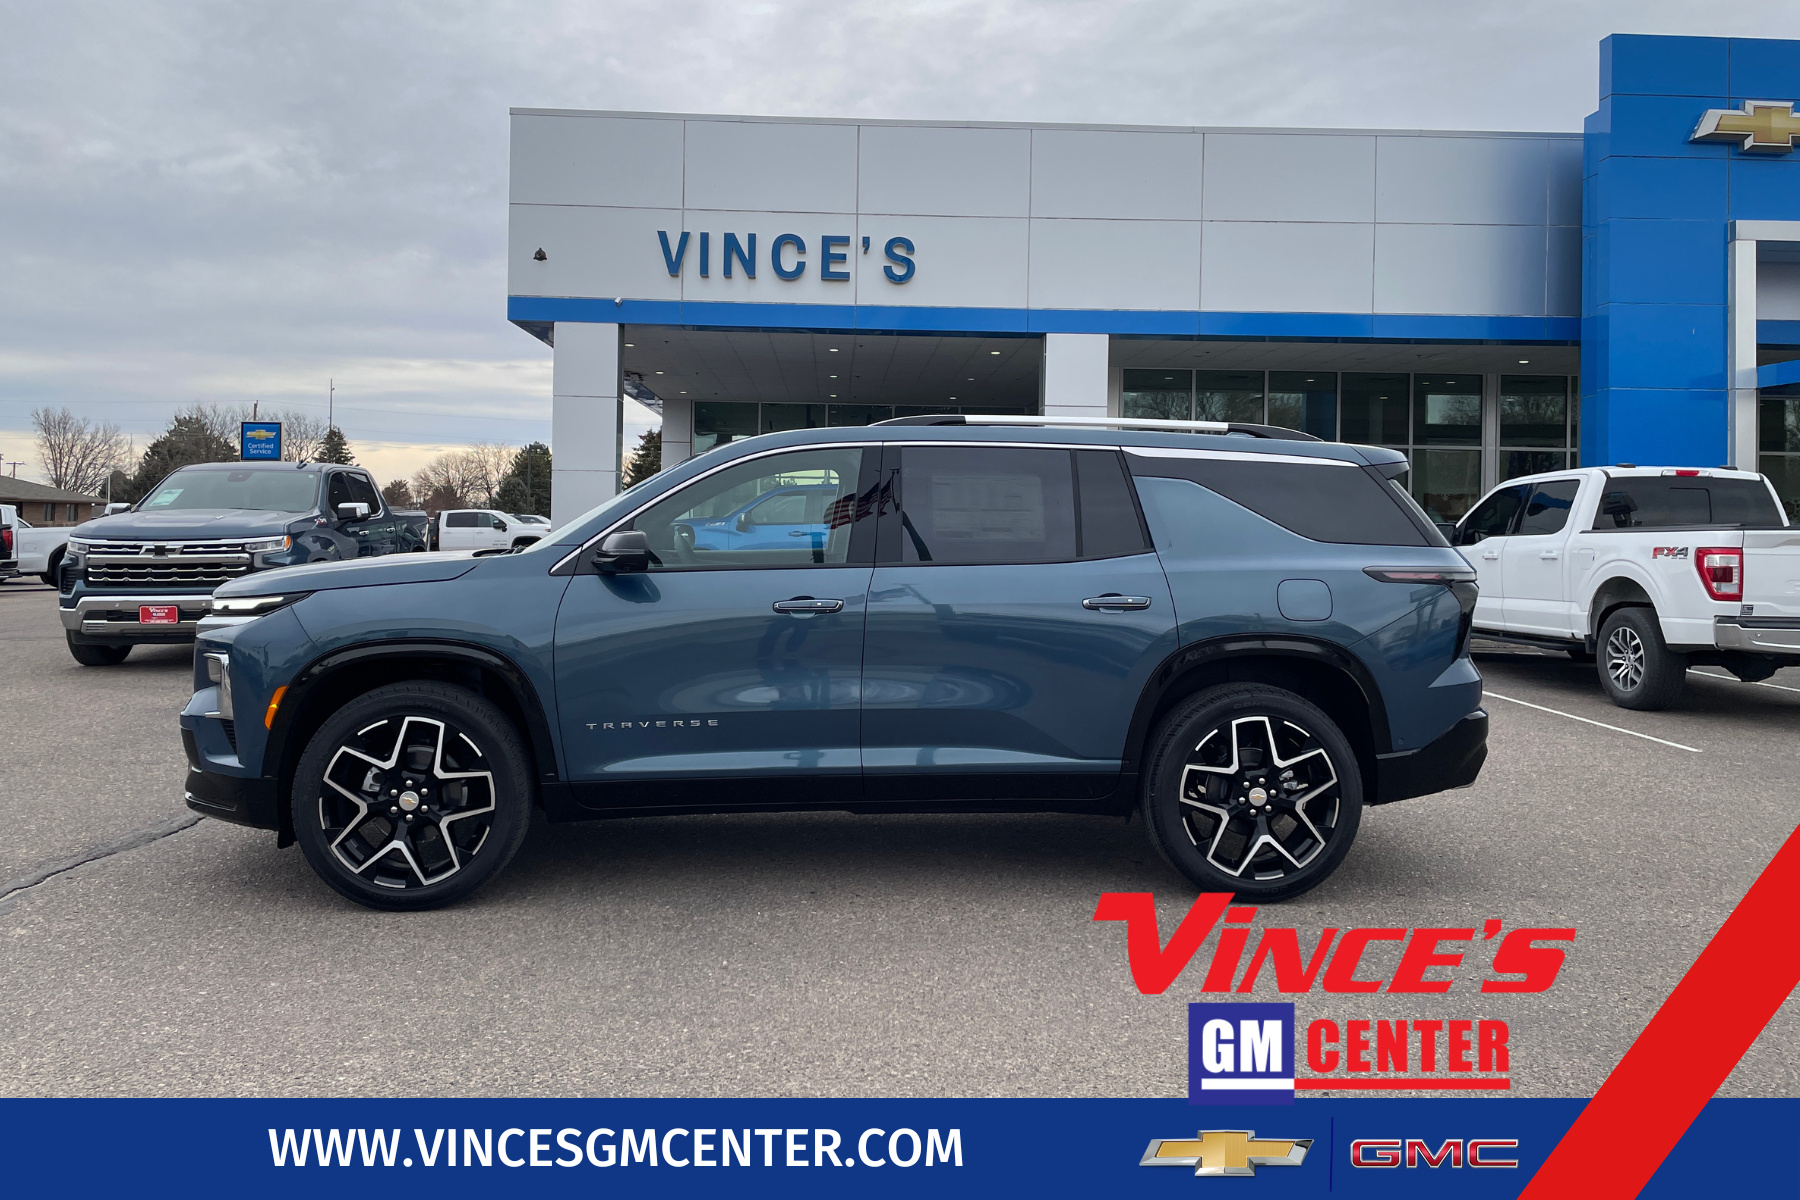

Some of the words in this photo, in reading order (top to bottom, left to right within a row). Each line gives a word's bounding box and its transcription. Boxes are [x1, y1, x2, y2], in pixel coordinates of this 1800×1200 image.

[657, 231, 916, 284] VINCE'S
[1652, 547, 1689, 559] FX4
[586, 719, 719, 730] TRAVERSE
